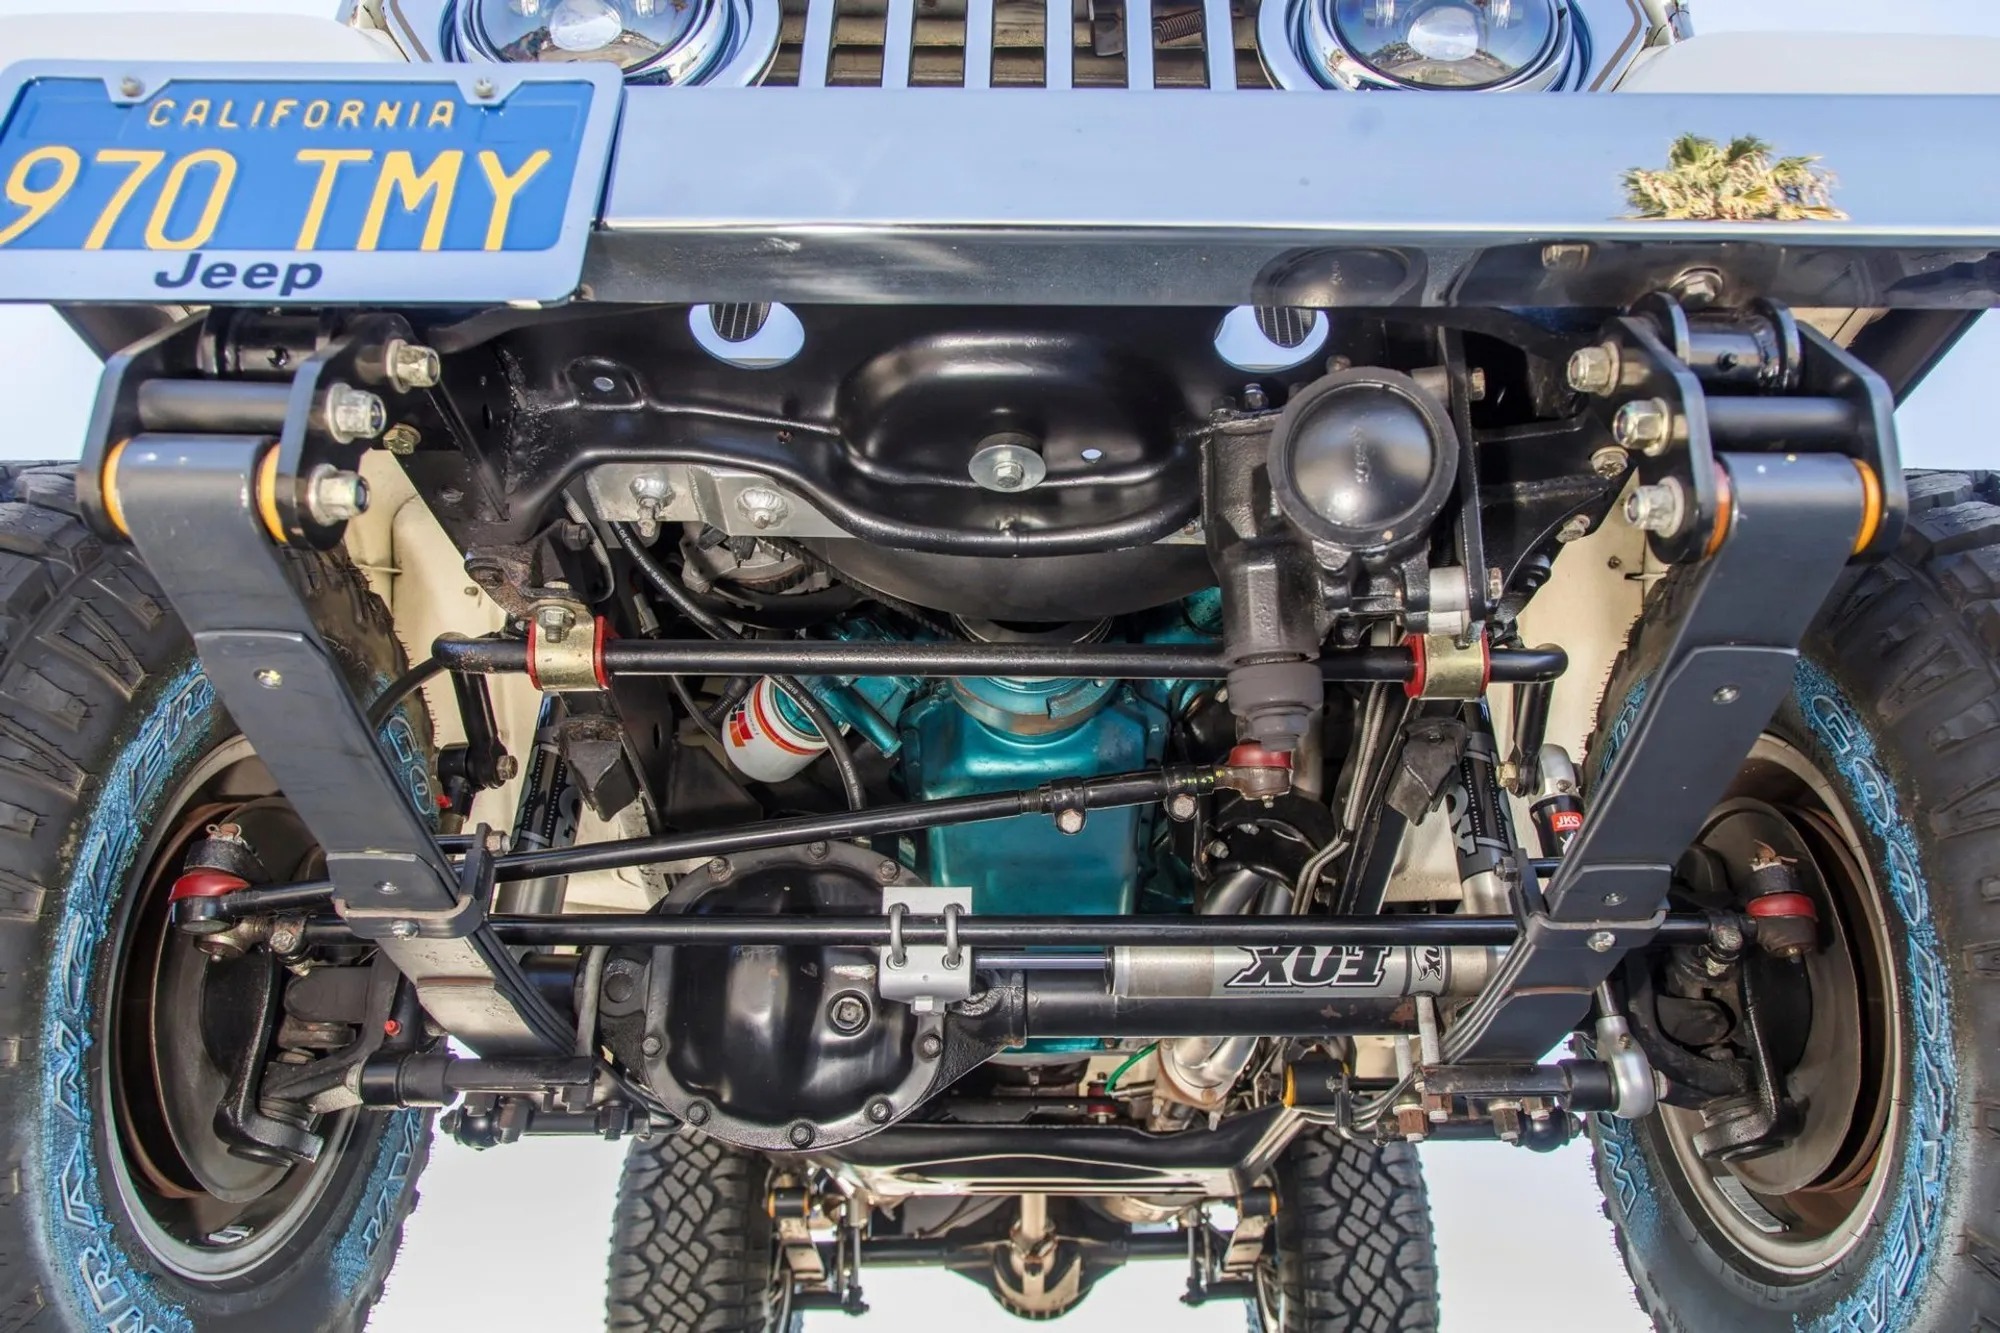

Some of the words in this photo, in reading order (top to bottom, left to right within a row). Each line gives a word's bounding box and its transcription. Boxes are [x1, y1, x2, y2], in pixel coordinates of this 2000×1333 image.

[148, 98, 454, 129] CALIFORNIA
[0, 146, 238, 251] 970
[296, 149, 553, 251] TMY
[155, 253, 323, 296] Jeep
[1556, 815, 1580, 828] JKS
[1224, 945, 1392, 987] FOX
[1812, 695, 1944, 1333] GOODYEA
